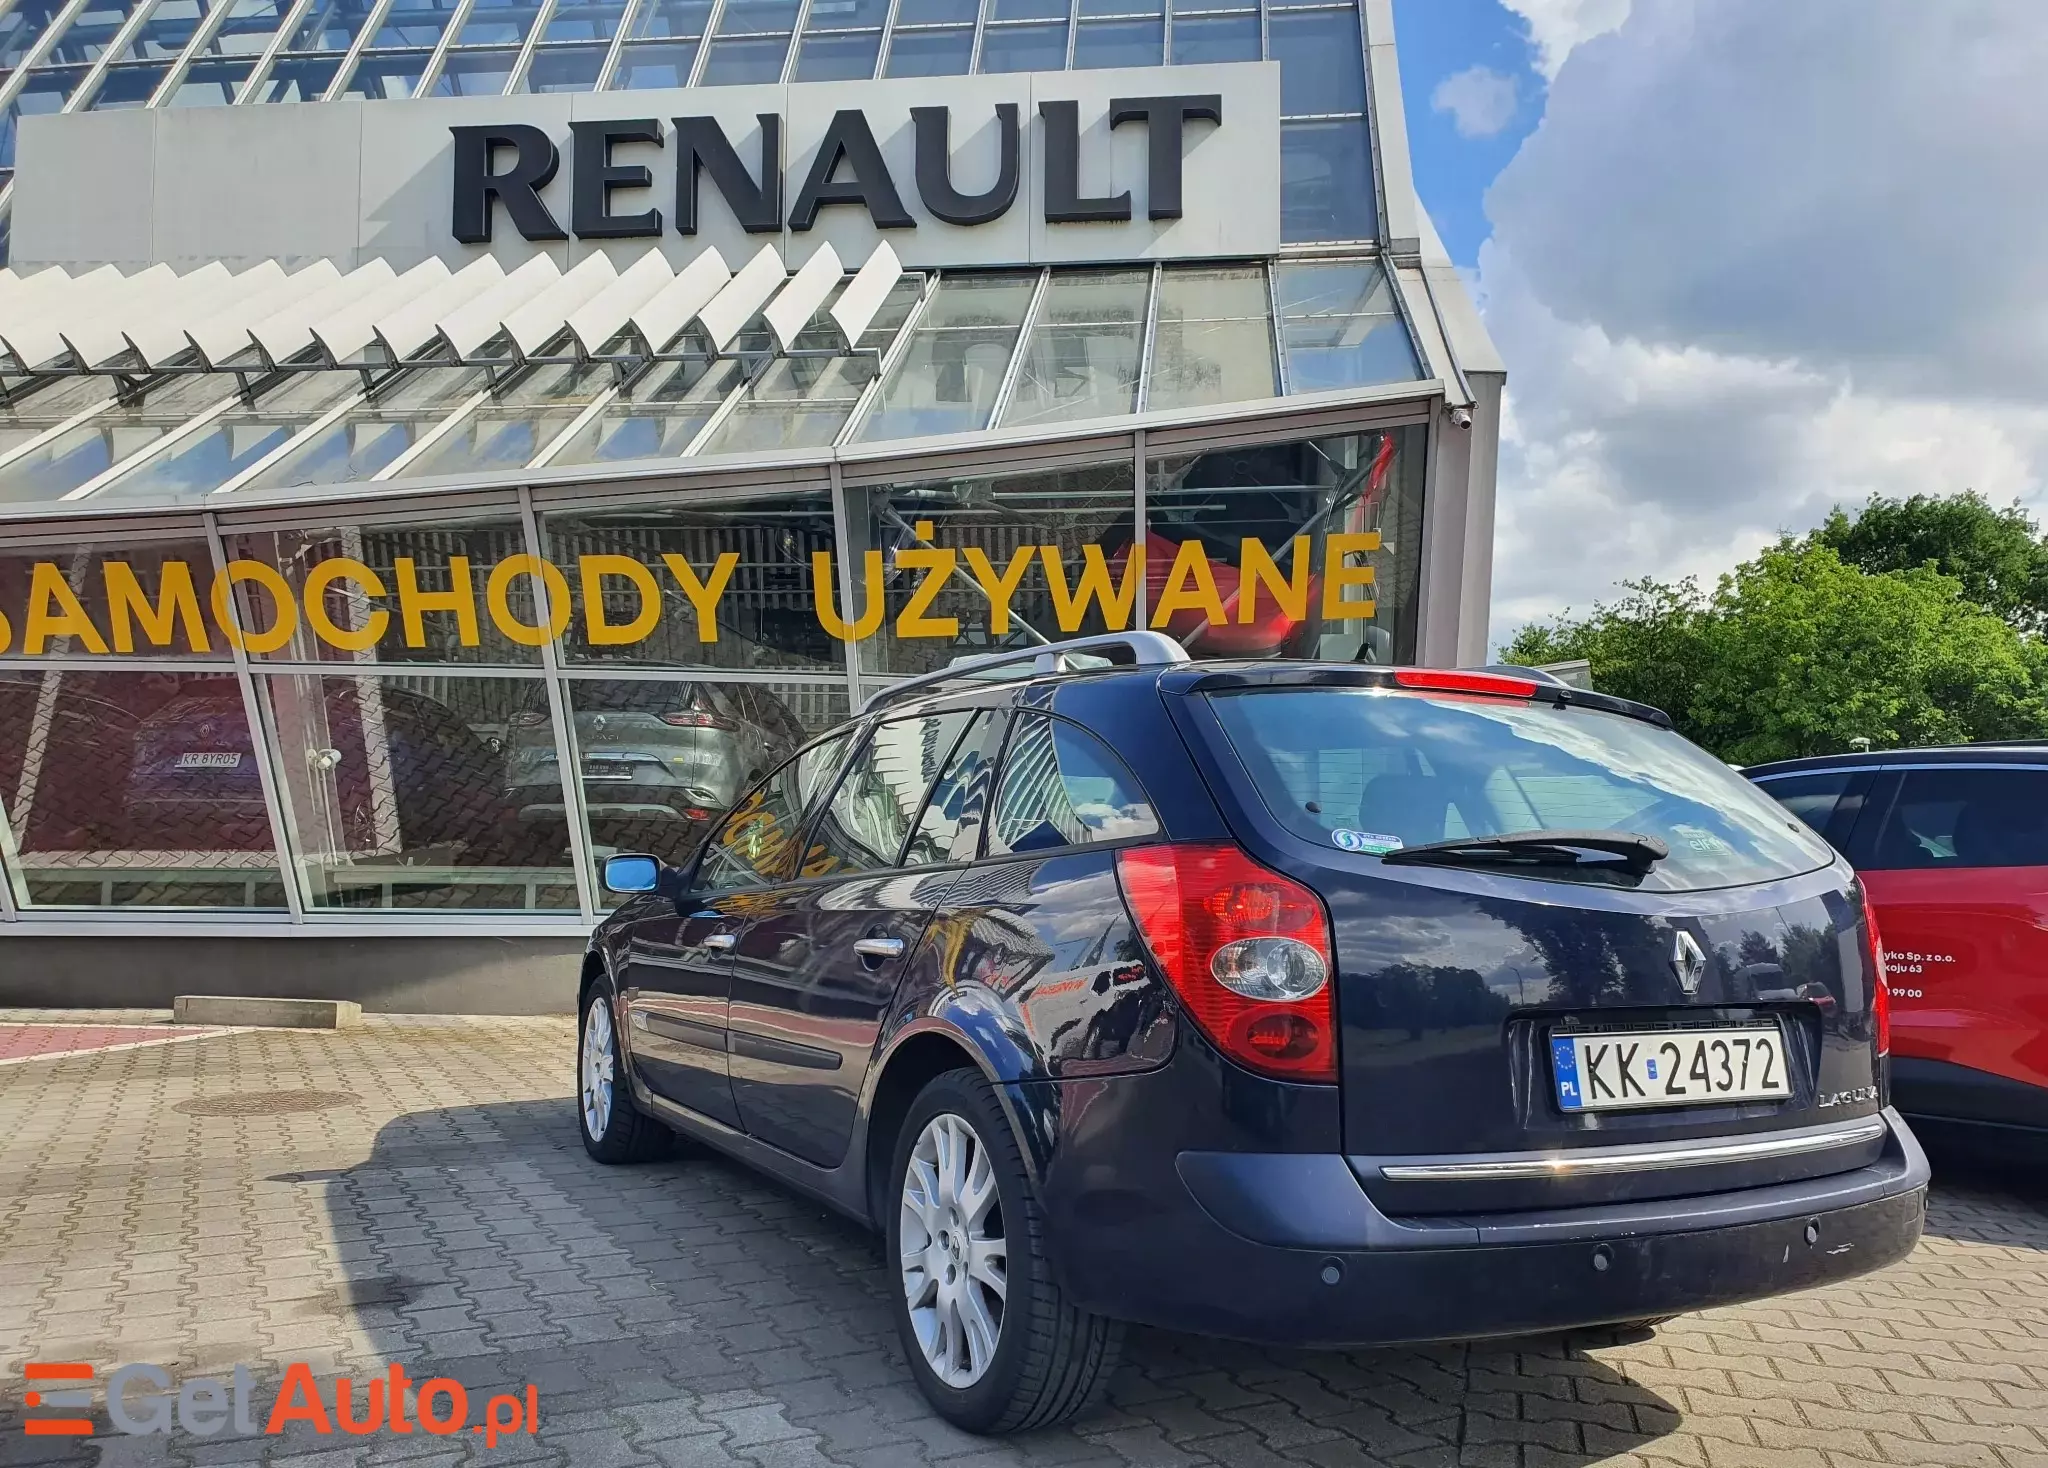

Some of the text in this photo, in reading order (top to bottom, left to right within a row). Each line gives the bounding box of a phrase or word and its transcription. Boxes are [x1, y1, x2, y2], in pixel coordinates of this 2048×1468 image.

[448, 94, 1222, 244] RENAULT
[0, 520, 1382, 655] AMOCHODY UŻYWANE
[182, 754, 198, 764] KR
[1906, 952, 1925, 963] Sp.
[1934, 954, 1956, 962] o.o.
[1909, 965, 1922, 973] 63
[1892, 988, 1906, 997] 99
[1907, 989, 1922, 998] 00
[1561, 1038, 1779, 1099] PL KK 24372
[1818, 1085, 1879, 1107] LAGUNA
